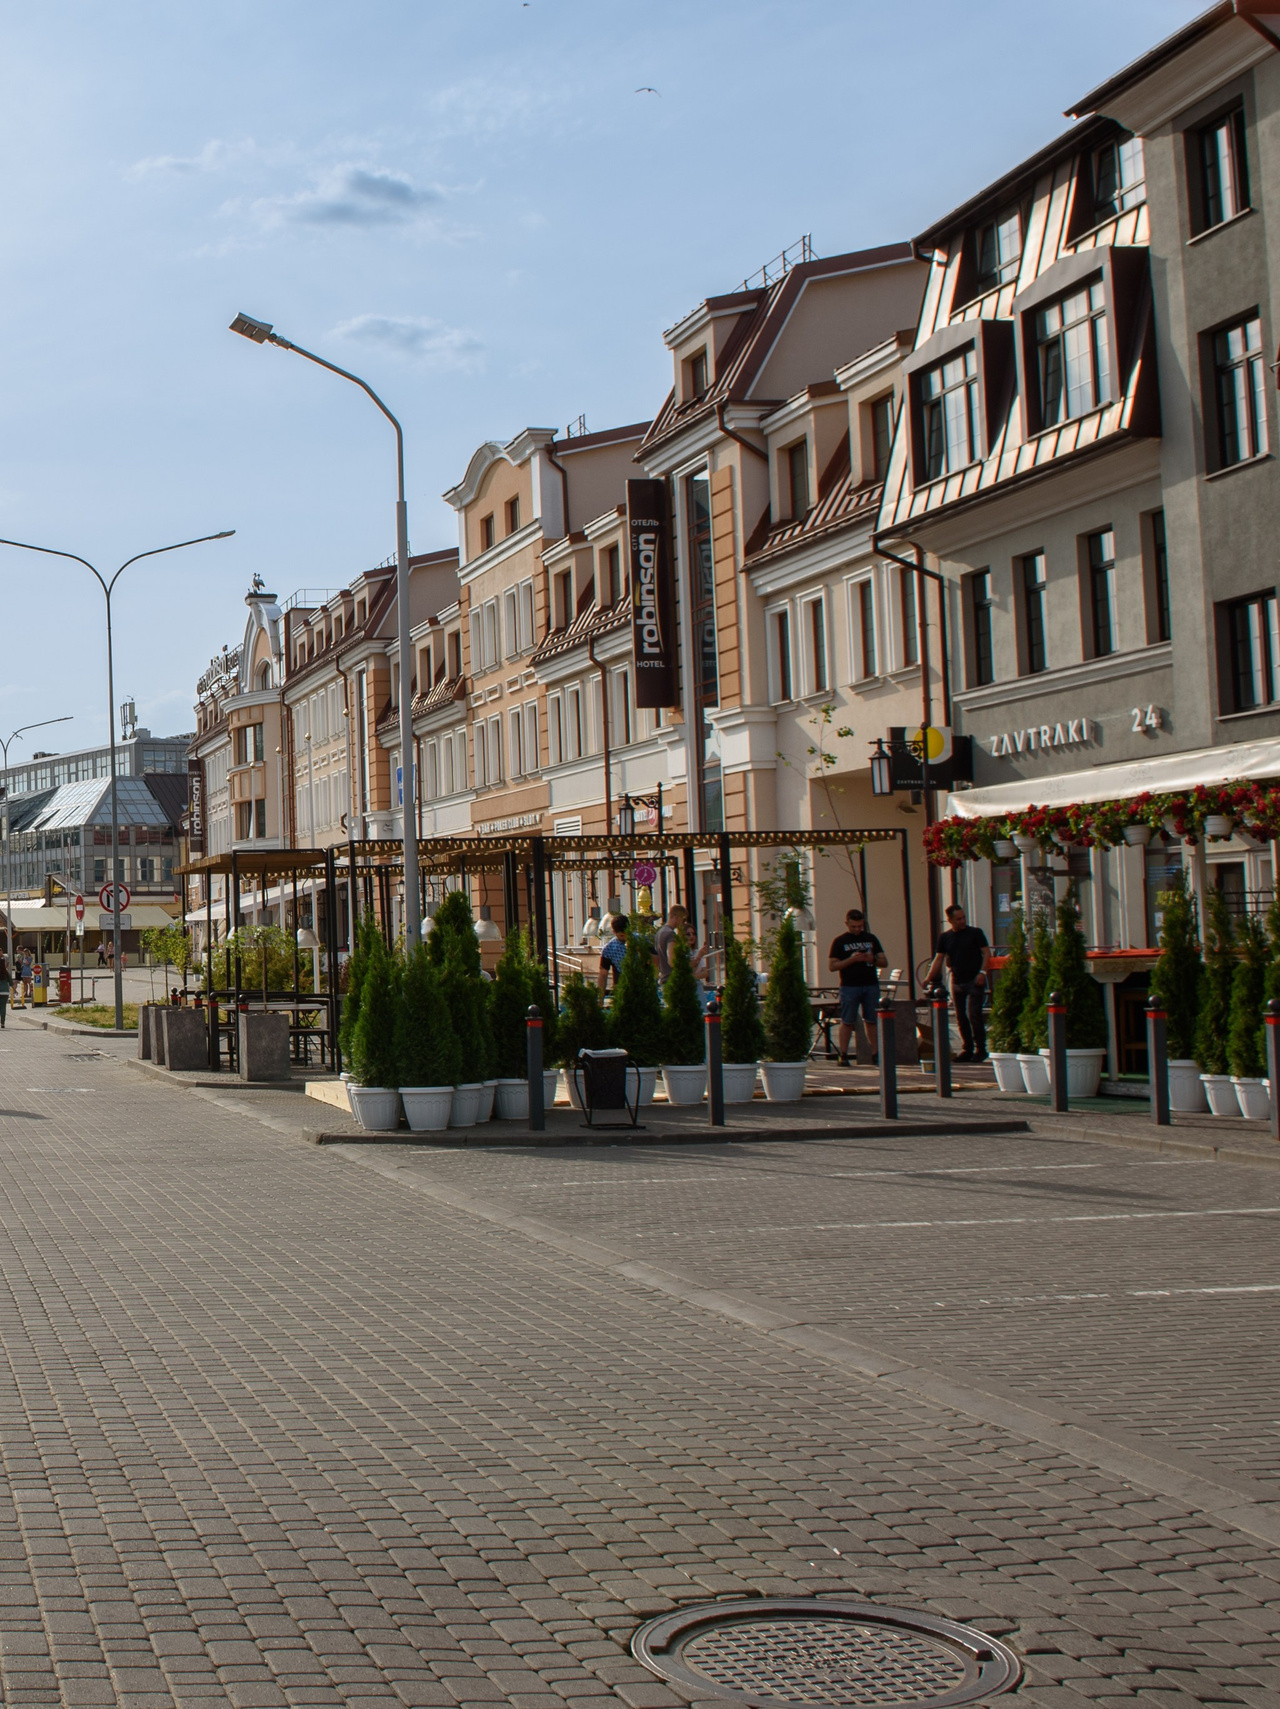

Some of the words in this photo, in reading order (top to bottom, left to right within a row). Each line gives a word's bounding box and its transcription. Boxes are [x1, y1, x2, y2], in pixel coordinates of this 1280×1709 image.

[631, 519, 659, 527] ОТЕЛЬ
[635, 533, 660, 654] robinson
[636, 660, 665, 668] HOTEL
[990, 717, 1089, 757] ZAVTRAKI
[1131, 704, 1161, 732] 24
[190, 777, 202, 835] robinson
